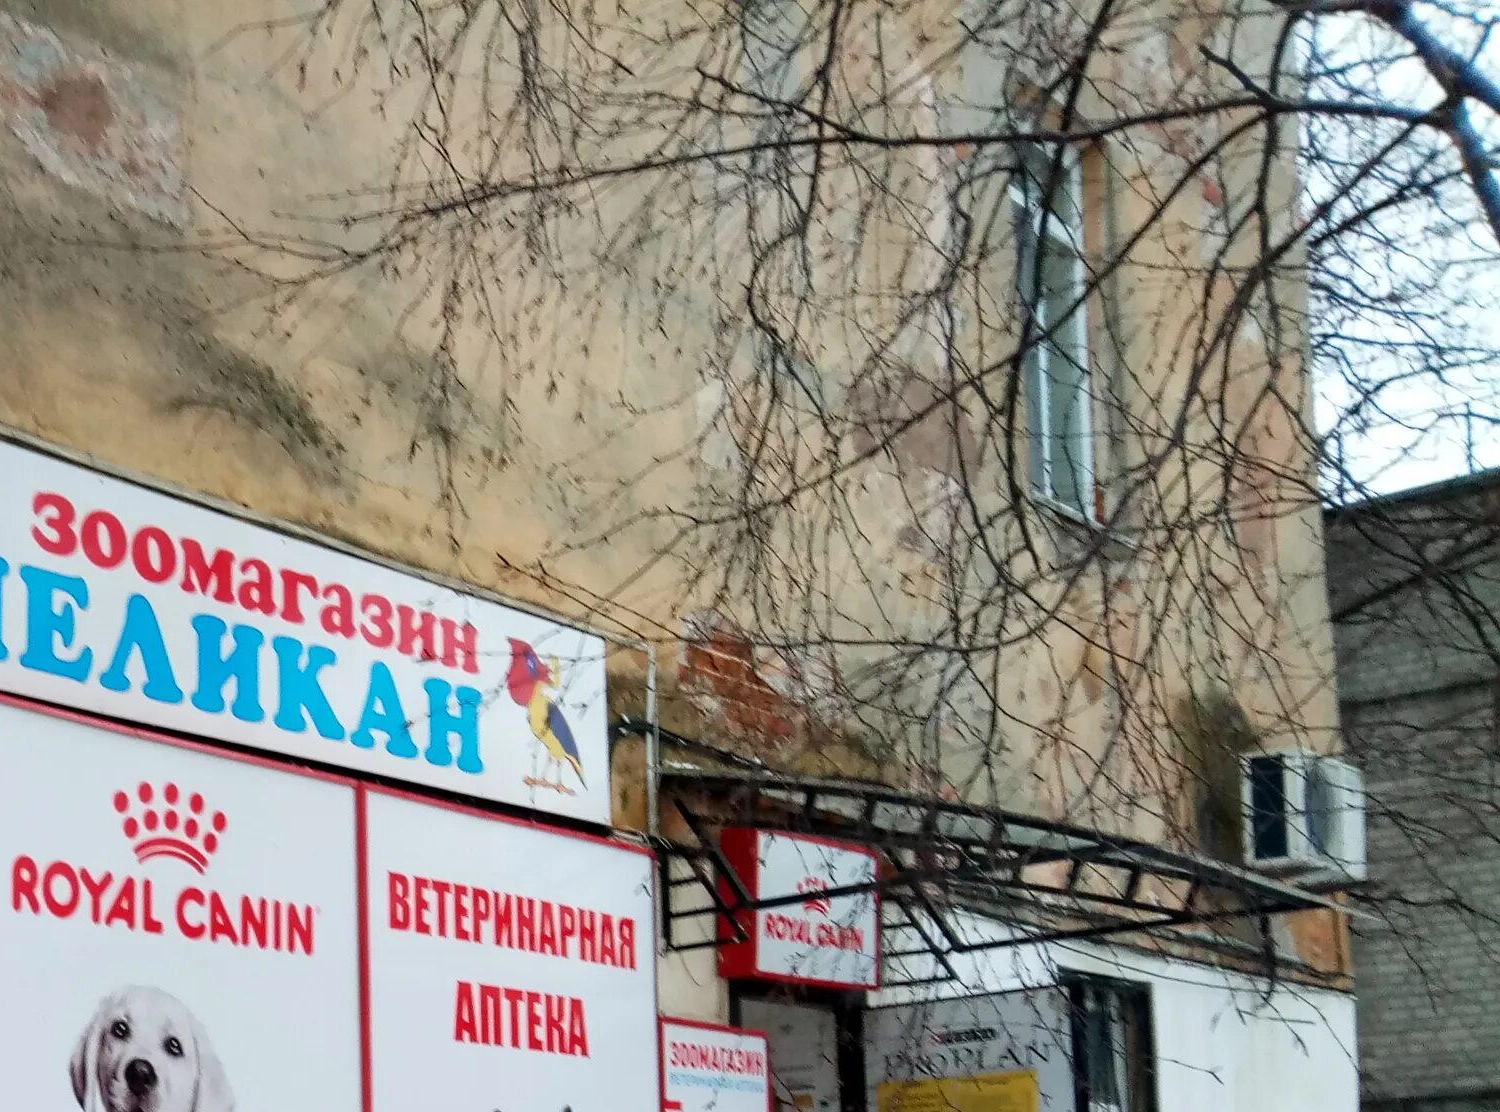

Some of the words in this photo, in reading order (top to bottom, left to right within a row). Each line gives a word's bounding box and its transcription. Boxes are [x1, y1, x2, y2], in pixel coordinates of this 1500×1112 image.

[11, 855, 164, 936] ROYAL
[174, 886, 316, 954] CANIN
[387, 870, 638, 971] ВЕТЕРИНАРНАЯ
[764, 912, 812, 945] ROYAL
[455, 980, 591, 1059] АПТЕКА
[669, 1040, 765, 1077] ЗООМАГАЗИН
